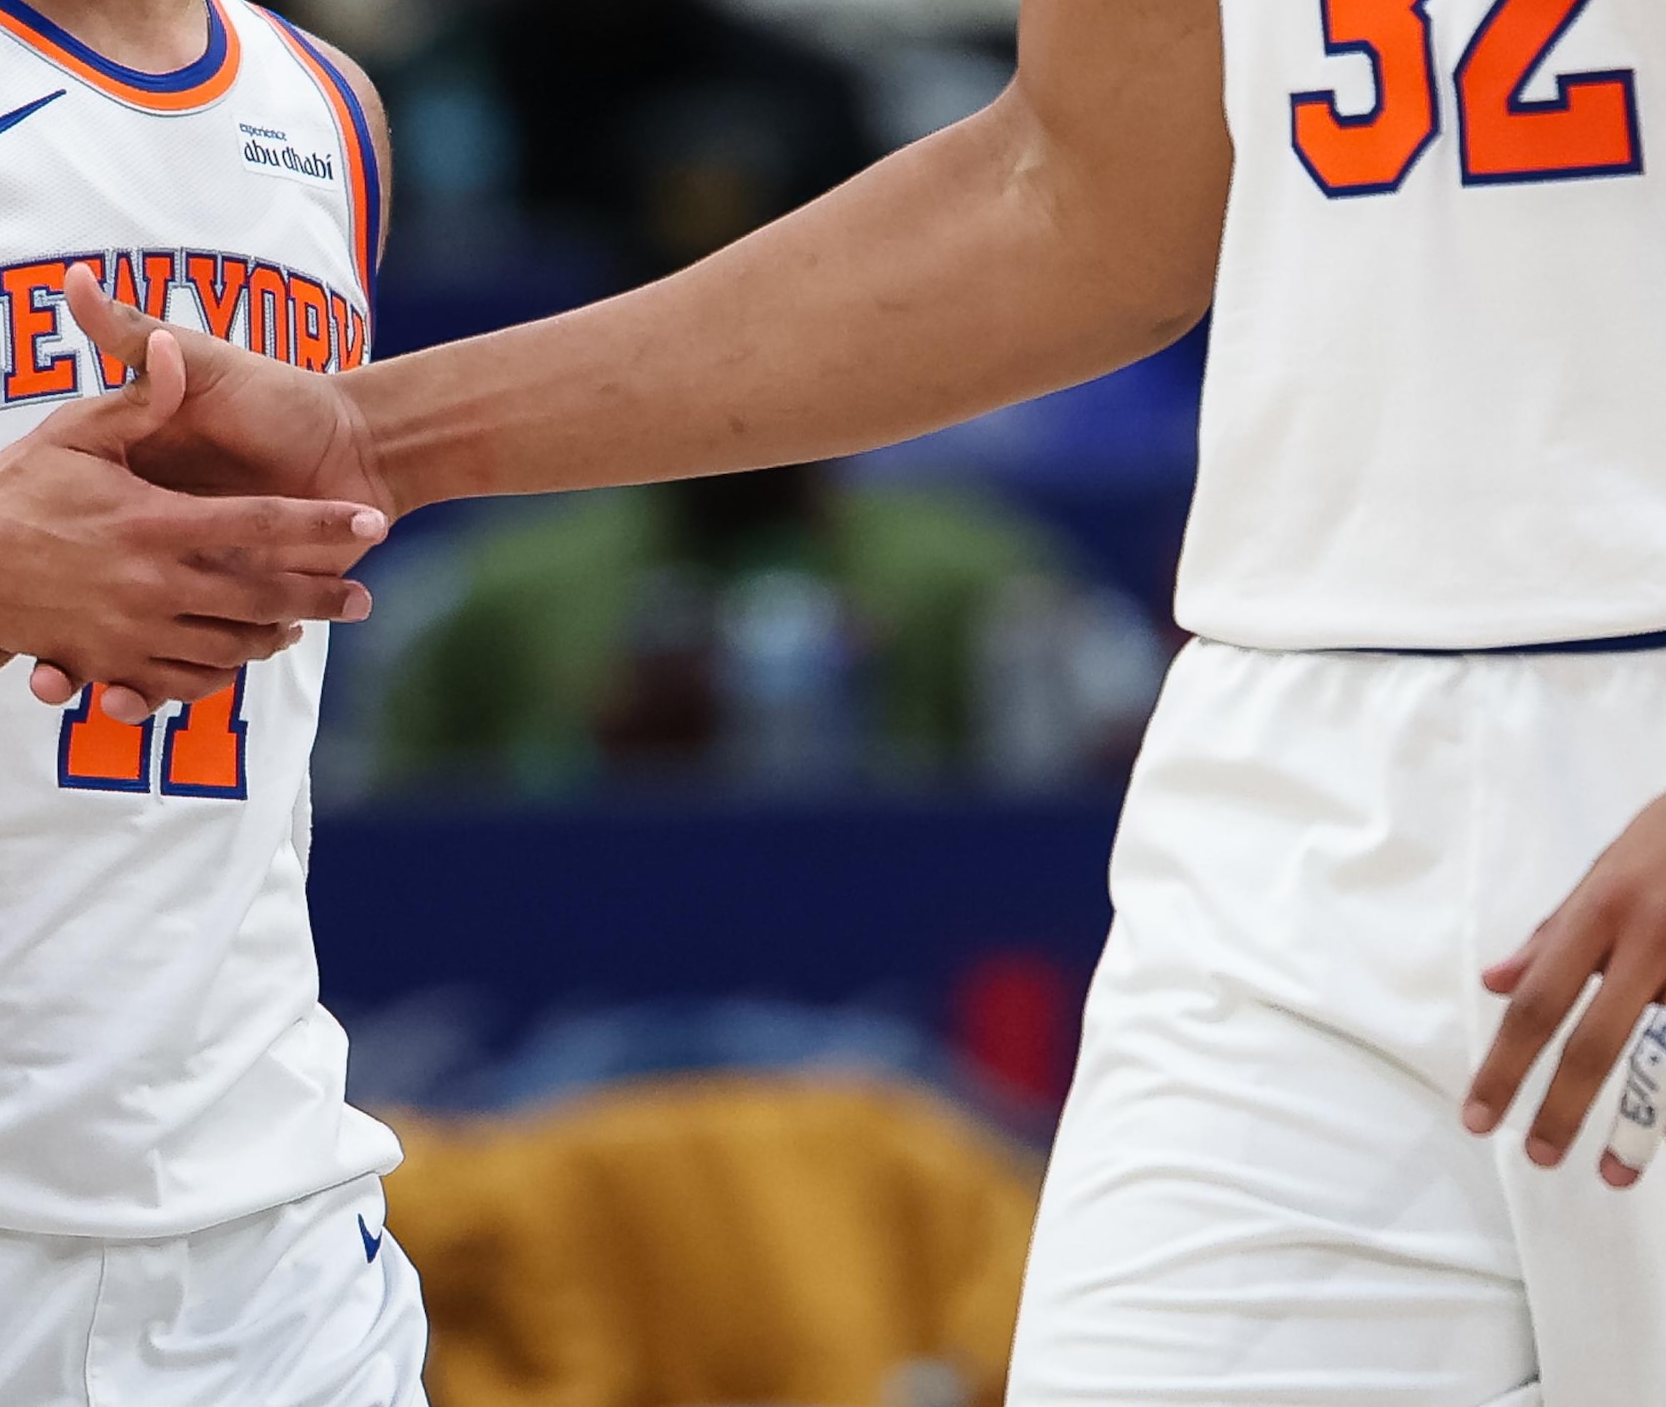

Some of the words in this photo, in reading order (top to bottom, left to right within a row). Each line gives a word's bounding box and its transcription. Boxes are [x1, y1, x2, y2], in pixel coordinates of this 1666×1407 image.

[238, 122, 287, 141] experience
[244, 139, 281, 167] abu
[281, 146, 334, 180] dhabi
